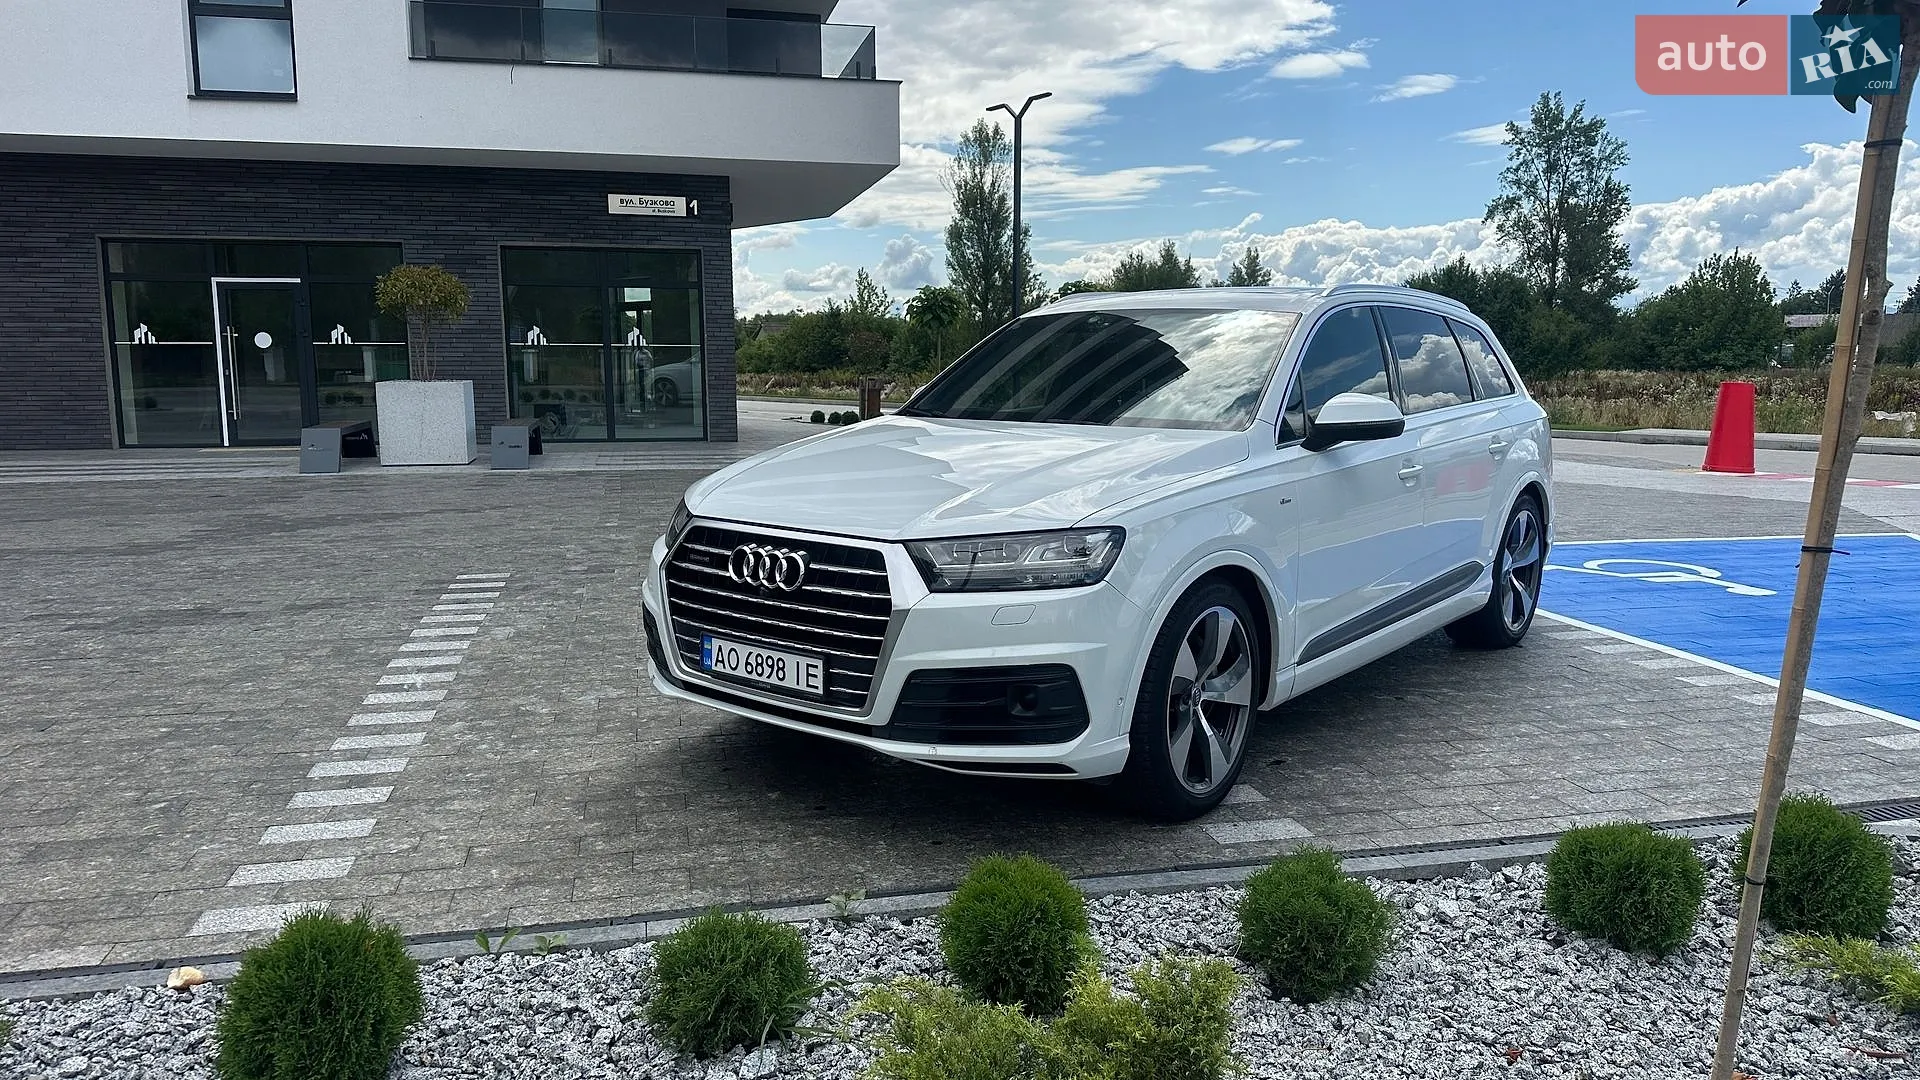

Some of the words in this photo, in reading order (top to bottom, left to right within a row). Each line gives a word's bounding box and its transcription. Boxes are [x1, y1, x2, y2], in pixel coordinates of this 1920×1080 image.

[619, 198, 637, 207] вул.
[639, 198, 675, 207] Бузкова
[689, 200, 698, 215] 1
[703, 657, 712, 666] UA
[714, 644, 740, 671] AO
[744, 651, 786, 682] 6898
[795, 660, 819, 690] IE
